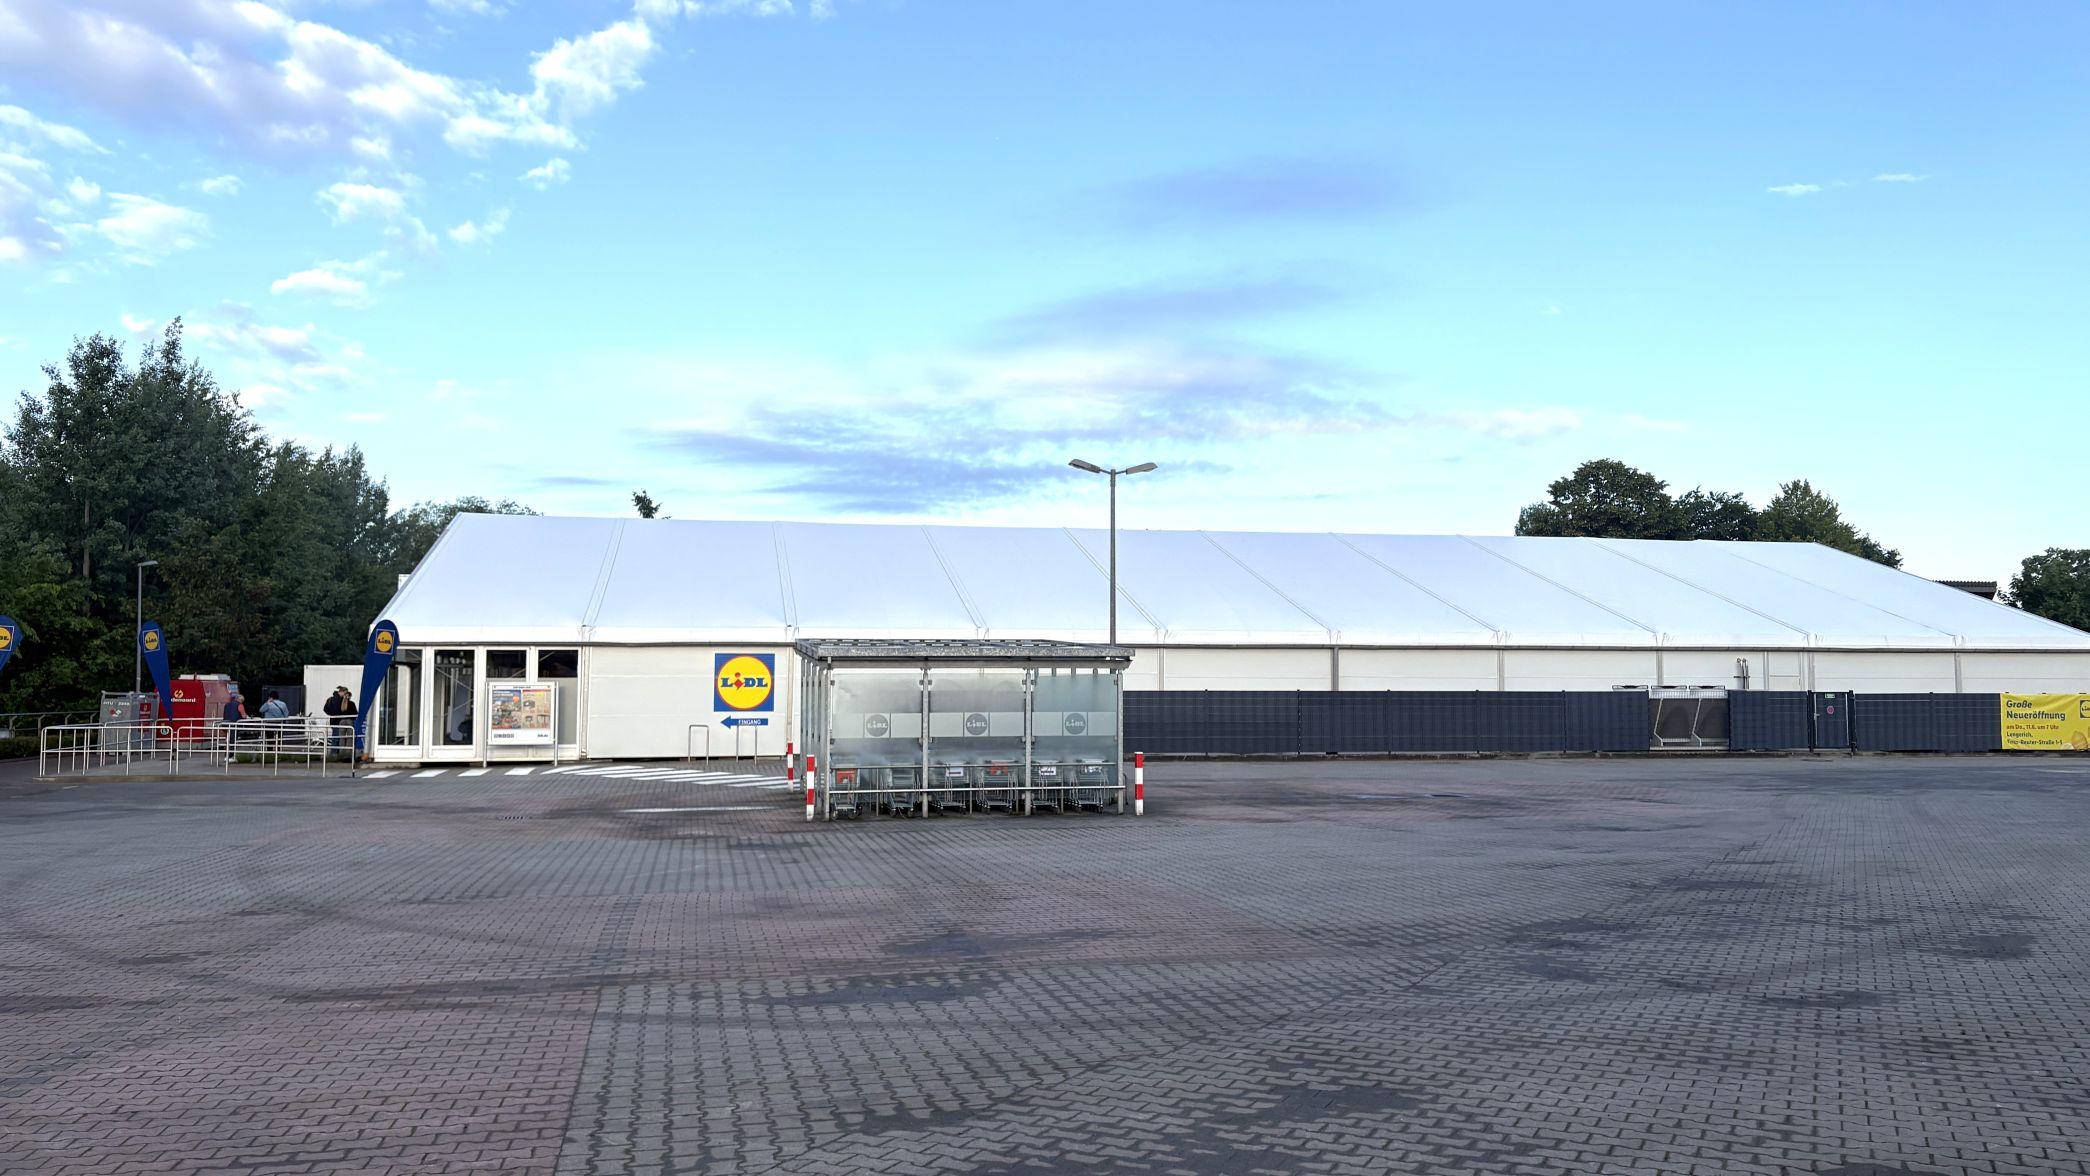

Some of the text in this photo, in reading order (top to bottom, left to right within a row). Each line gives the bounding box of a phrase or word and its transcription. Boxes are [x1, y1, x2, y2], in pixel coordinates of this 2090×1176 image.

[720, 672, 768, 691] LIDL
[2006, 700, 2033, 708] Große
[2006, 710, 2066, 721] Neueröffnung
[867, 720, 888, 728] LIDL
[967, 719, 986, 728] LIDL
[1065, 719, 1085, 727] LIDL
